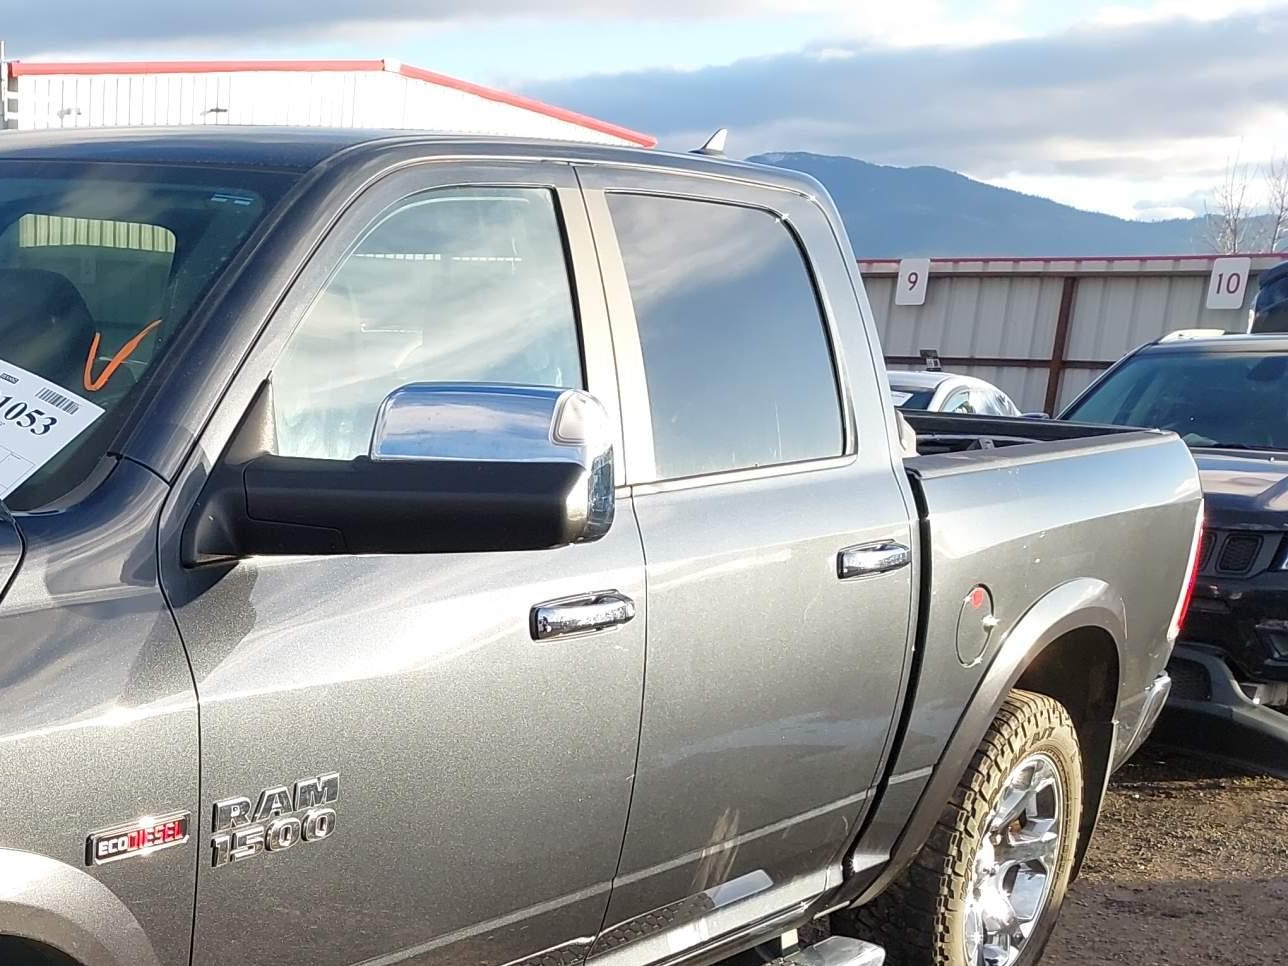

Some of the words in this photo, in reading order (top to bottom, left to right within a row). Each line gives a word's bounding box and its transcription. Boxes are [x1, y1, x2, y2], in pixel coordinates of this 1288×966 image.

[907, 271, 920, 291] 9
[1215, 272, 1241, 295] 10
[212, 771, 340, 833] RAM
[98, 821, 183, 857] ECODIESEL
[210, 807, 337, 867] 1500
